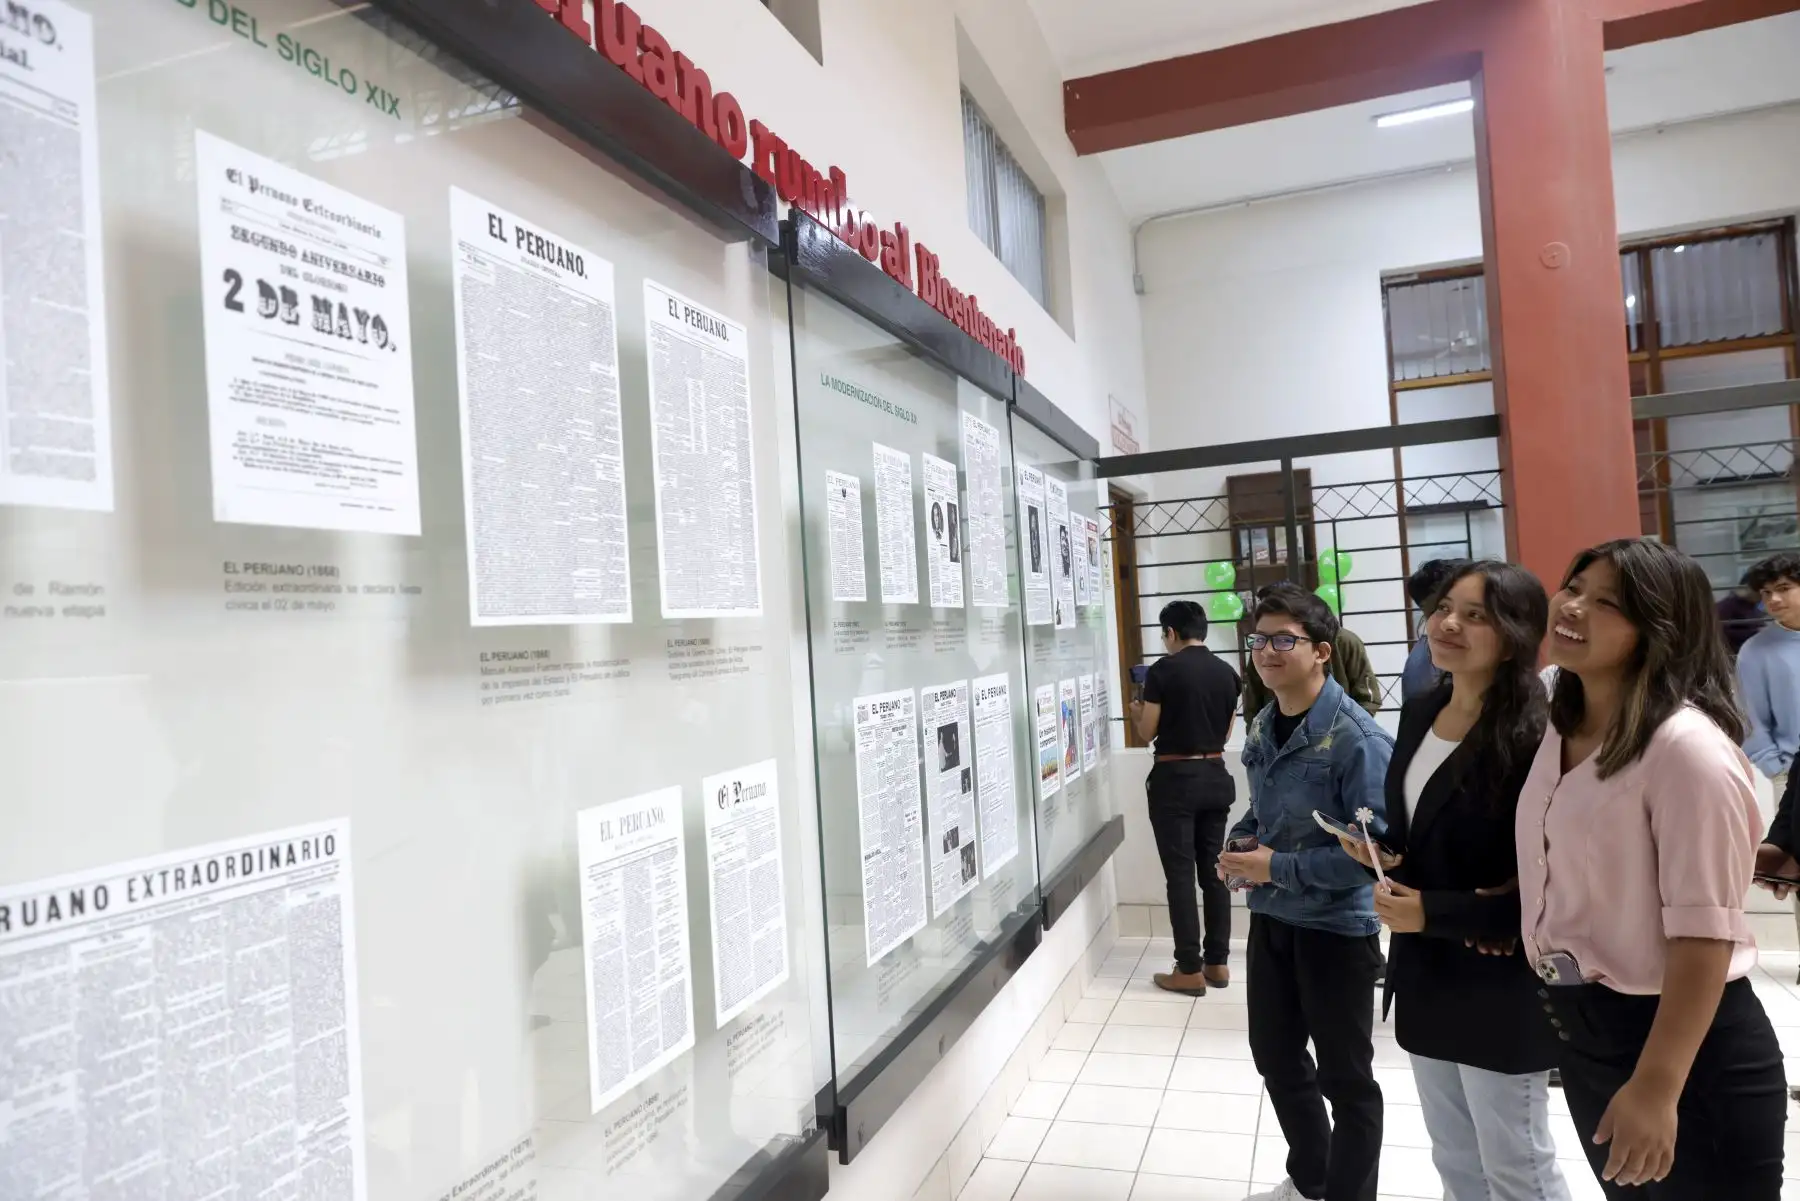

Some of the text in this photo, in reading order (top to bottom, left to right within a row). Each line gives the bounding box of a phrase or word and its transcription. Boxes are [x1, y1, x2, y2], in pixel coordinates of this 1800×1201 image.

[208, 0, 401, 120] DEL SIGLO XIX
[231, 224, 386, 288] SEGUNDO ANIVERSARIO
[488, 212, 588, 279] EL PERUANO.
[750, 119, 879, 262] rumbo
[880, 222, 913, 291] al
[915, 242, 1025, 377] Bicentenario
[223, 267, 397, 352] 2 DE MAYO.
[668, 298, 730, 342] EL PERUANO.
[820, 371, 831, 388] LA
[882, 399, 894, 415] DEL
[894, 405, 910, 422] SIGLO
[12, 582, 36, 596] de
[223, 561, 239, 574] EL
[243, 563, 305, 576] PERUANO
[480, 652, 490, 662] EL
[491, 650, 529, 662] PERUANO
[872, 699, 901, 714] EL PERUANO
[934, 692, 940, 702] EL
[718, 784, 730, 810] El
[600, 819, 614, 842] EL
[128, 833, 337, 903] EXTRAORDINARIO
[614, 1104, 643, 1131] PERUANO
[452, 1153, 509, 1198] Extraordinario
